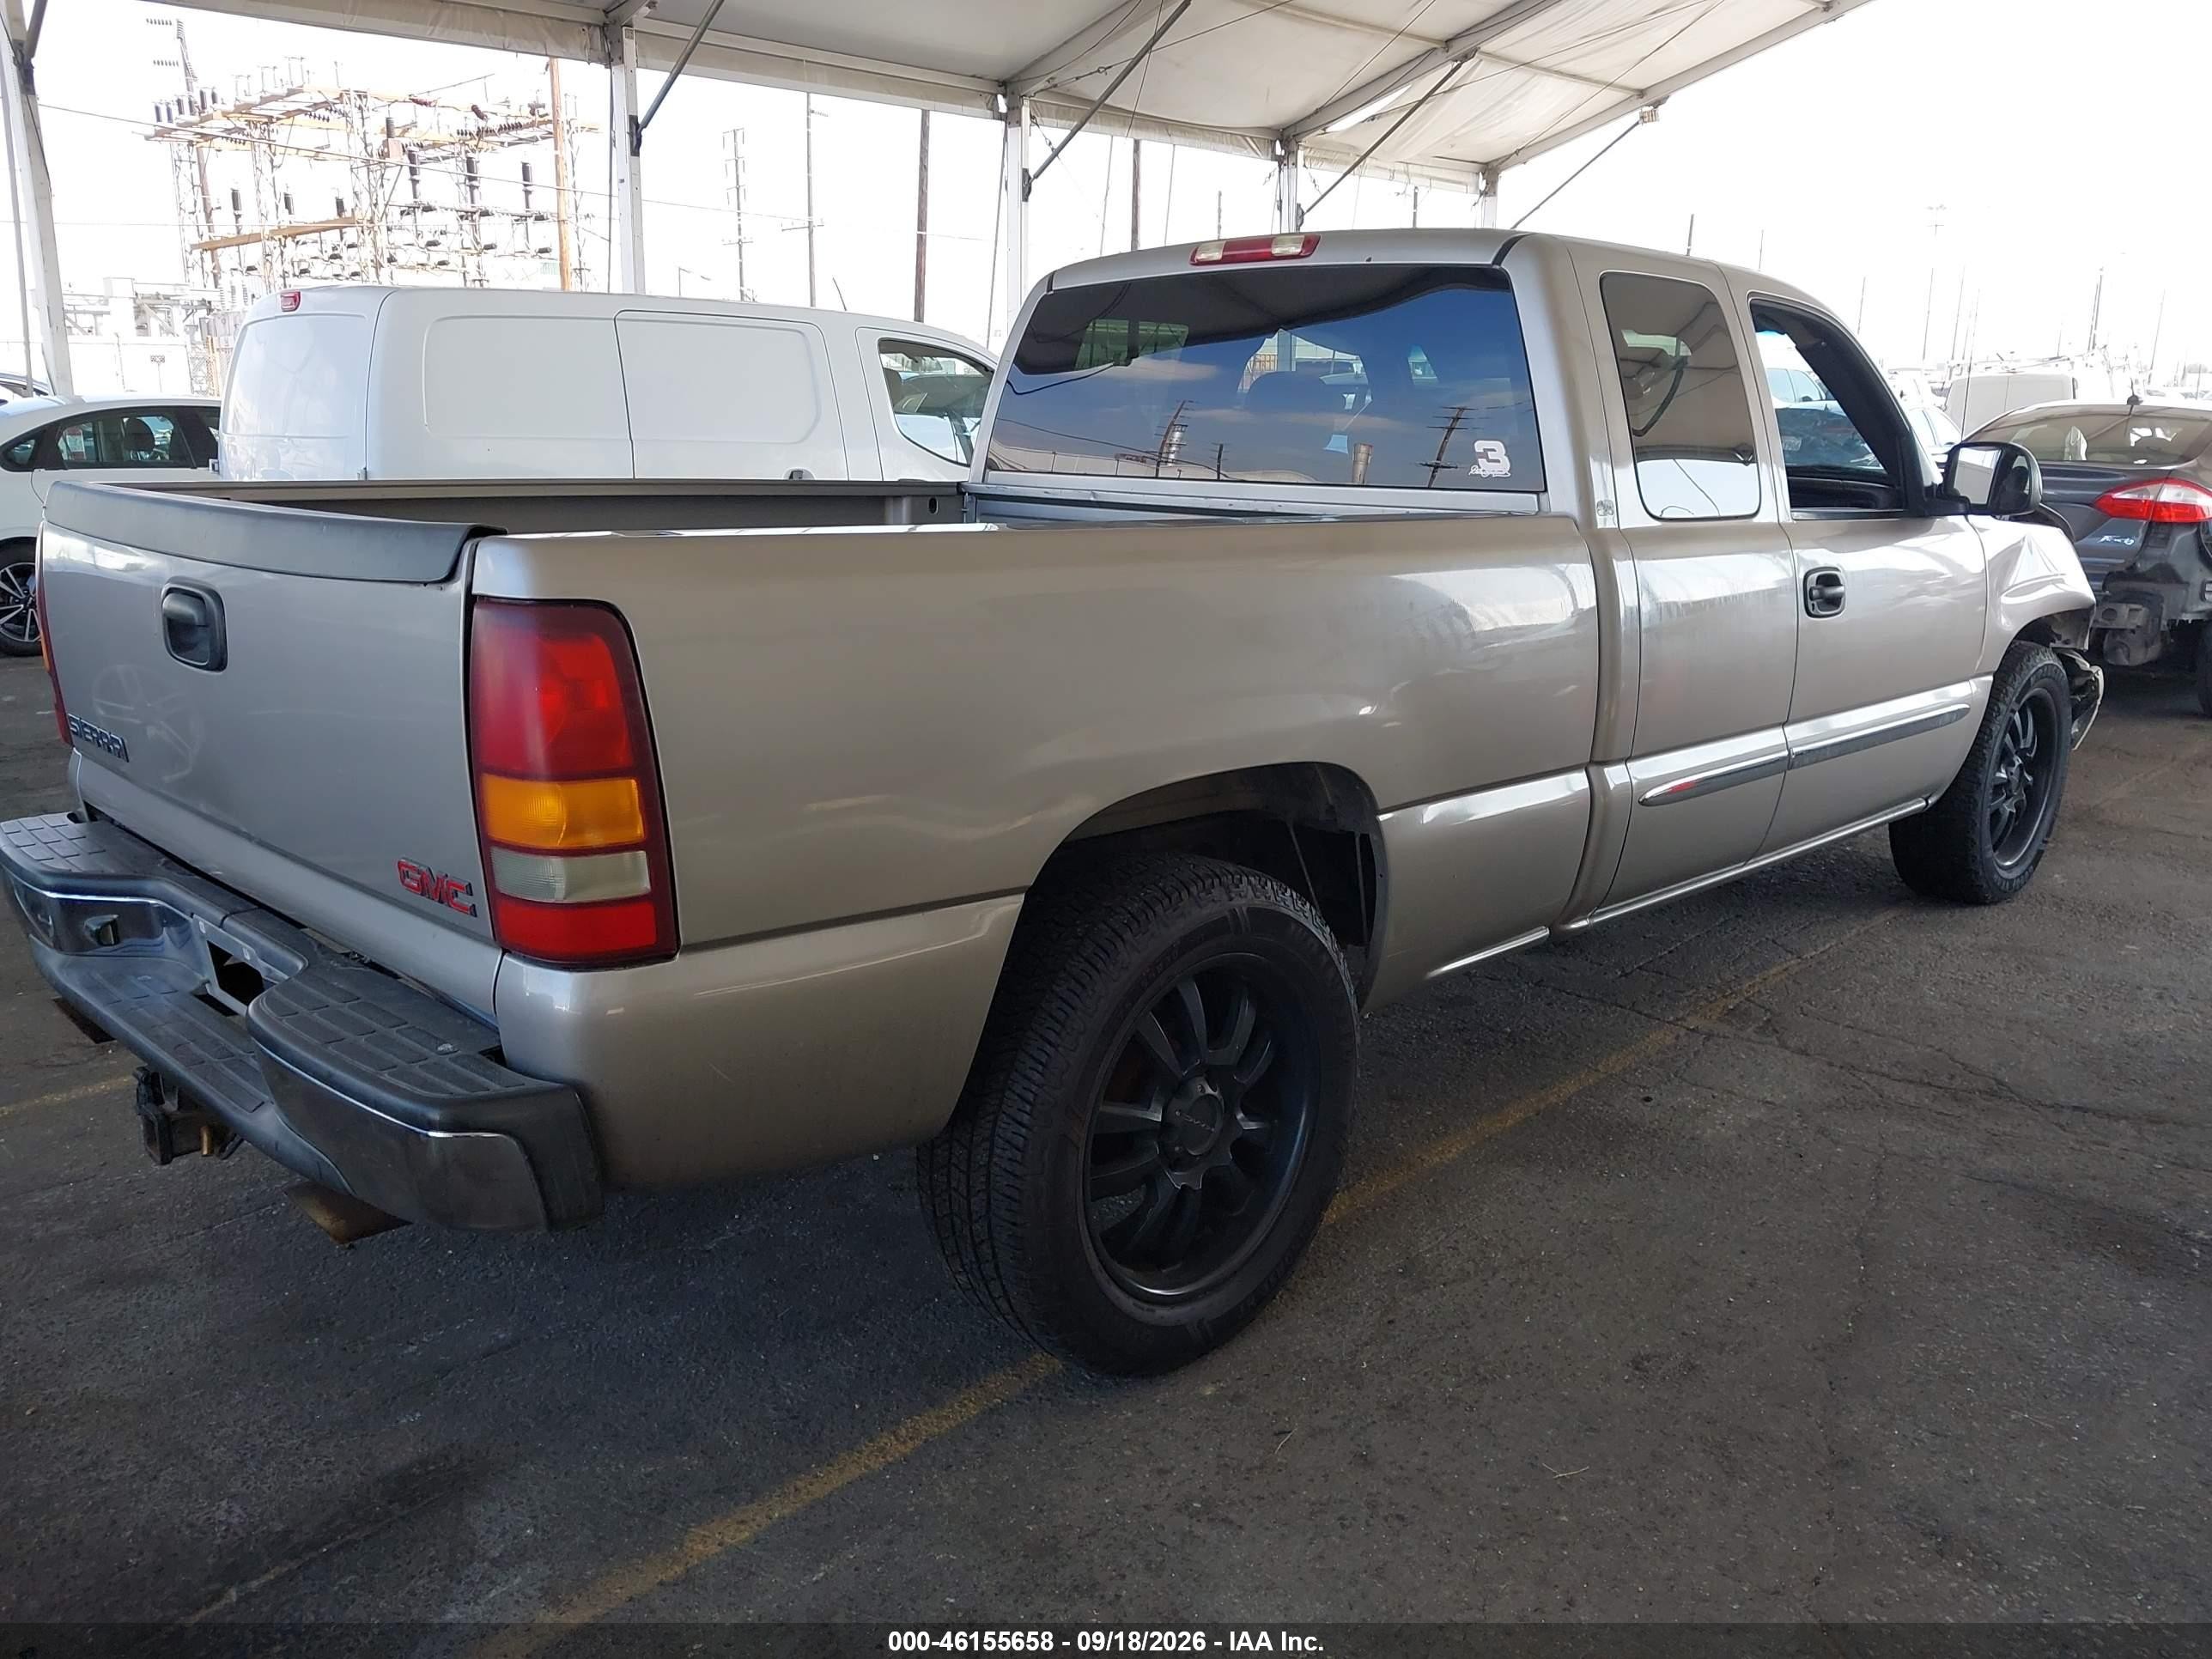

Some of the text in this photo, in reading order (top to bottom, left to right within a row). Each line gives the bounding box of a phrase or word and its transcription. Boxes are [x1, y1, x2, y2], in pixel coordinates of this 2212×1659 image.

[1474, 440, 1510, 473] 3
[68, 713, 130, 763] SIERRA
[398, 858, 477, 918] GMC
